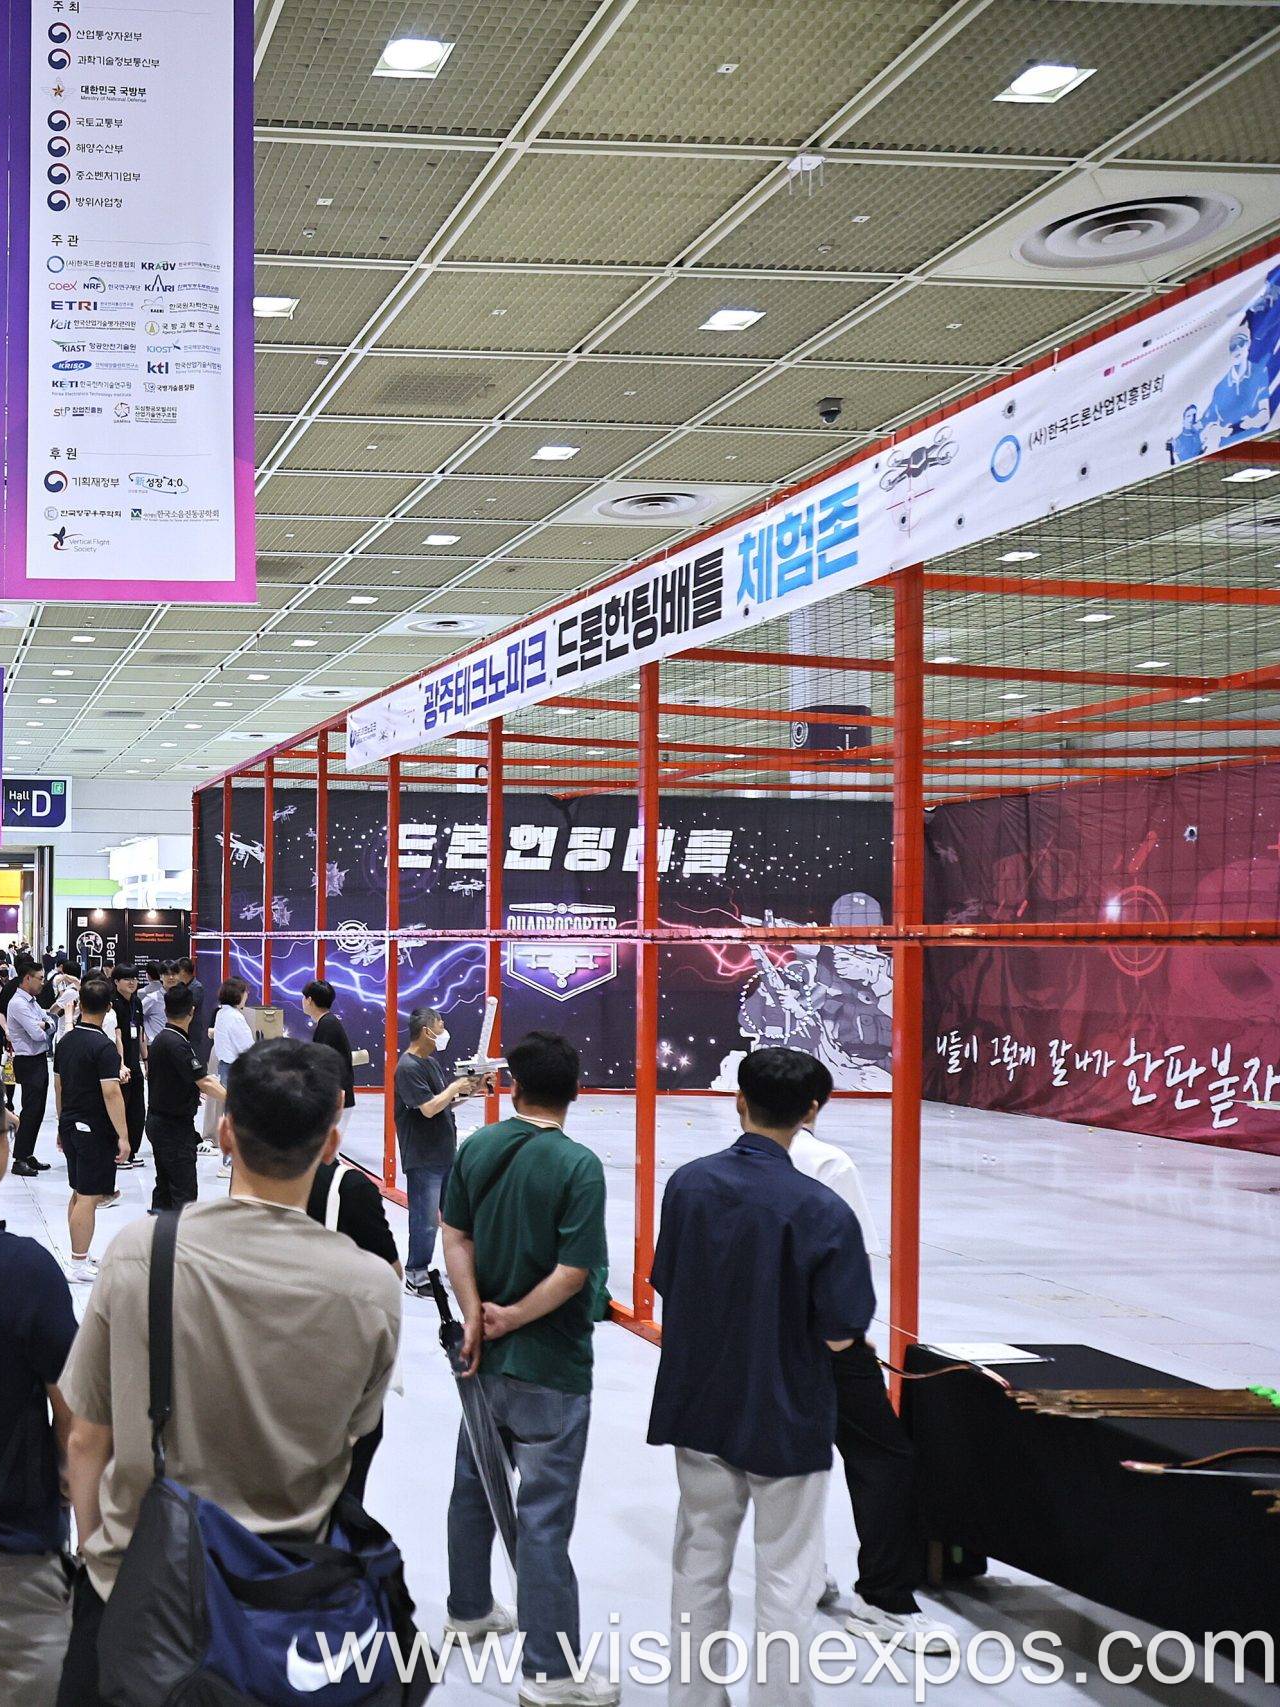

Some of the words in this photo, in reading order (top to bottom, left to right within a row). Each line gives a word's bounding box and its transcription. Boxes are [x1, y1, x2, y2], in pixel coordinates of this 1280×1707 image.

[76, 30, 143, 42] 산업통상자원부
[77, 55, 160, 68] 과학기술정보통신부
[80, 85, 117, 95] 대한민국
[120, 86, 147, 97] 국방부
[76, 117, 123, 129] 국토교통부
[76, 143, 124, 154] 해양수산부
[76, 170, 141, 182] 중소벤처기업부
[75, 197, 123, 209] 방위사업청
[83, 282, 102, 291] NRF
[51, 300, 98, 311] ETRI
[61, 344, 86, 352] KIAST
[1028, 374, 1166, 451] (사)한국드론산업진흥협회
[71, 476, 120, 488] 기획재정부
[423, 630, 548, 731] 광주테크노파크
[556, 547, 724, 678] 드론헌팅배틀
[736, 482, 860, 607] 체험존
[9, 790, 30, 800] Hall
[31, 790, 51, 817] D
[384, 822, 733, 874] 드론헌팅배틀
